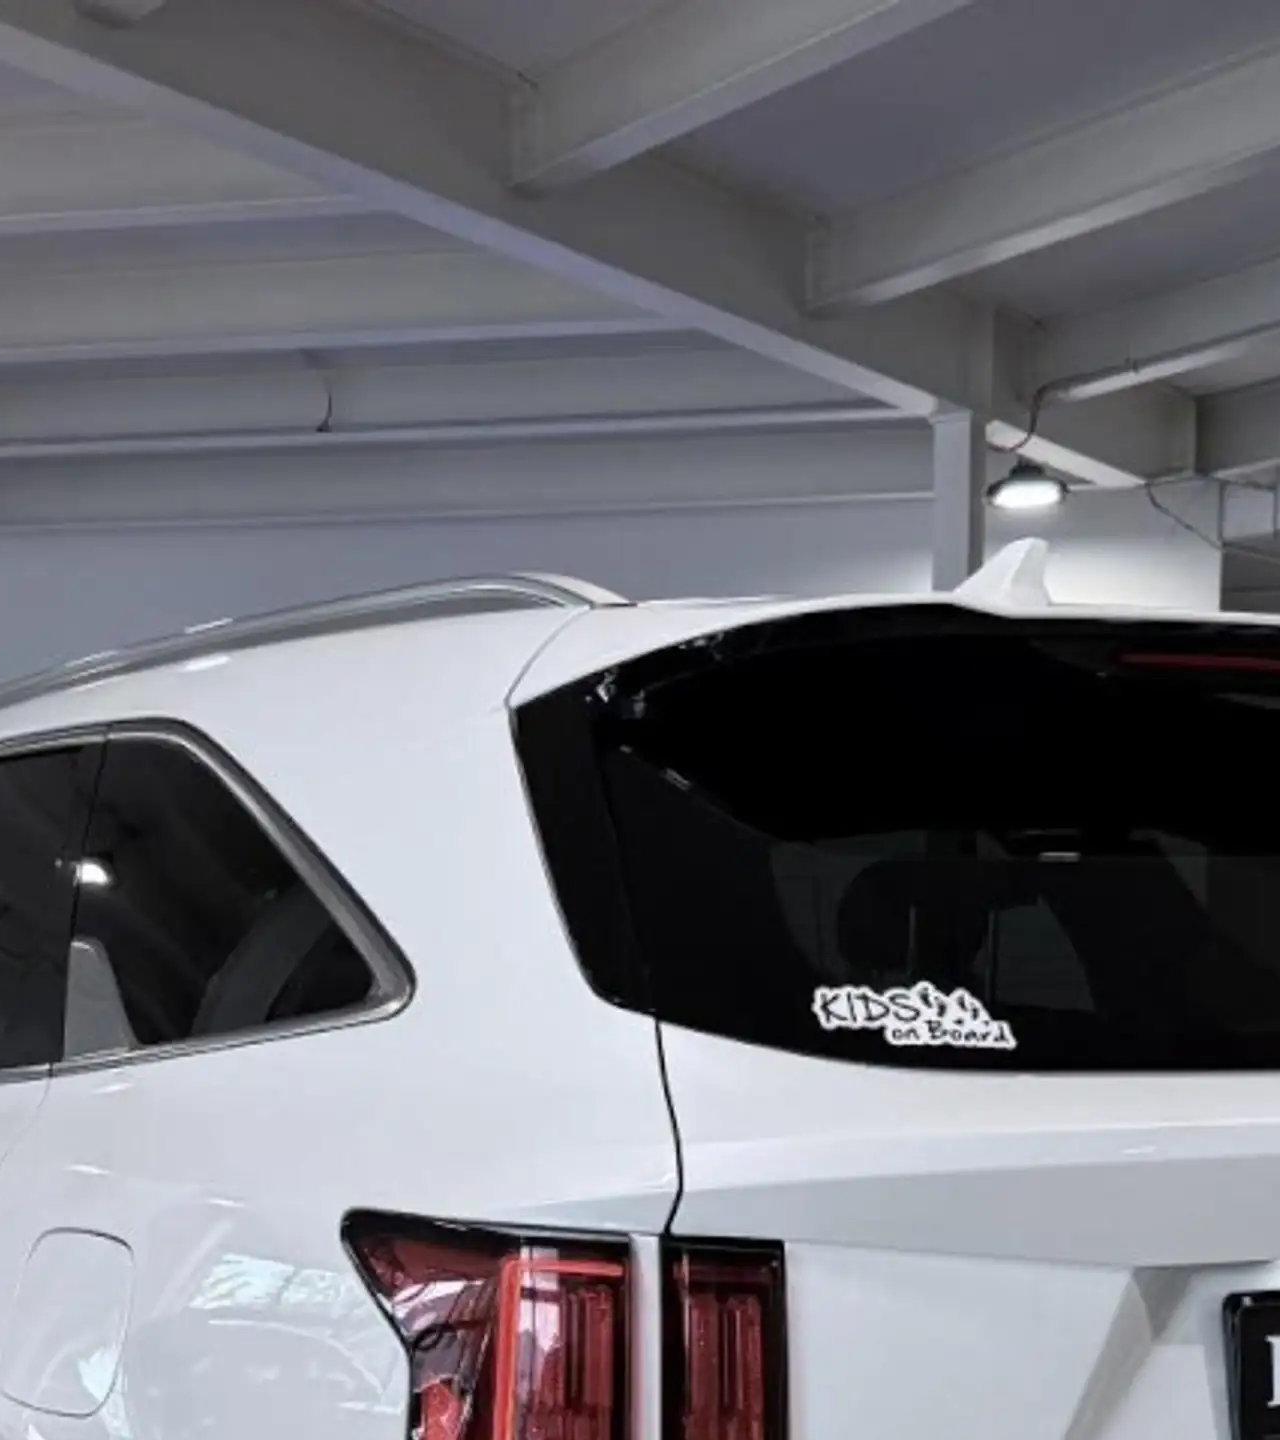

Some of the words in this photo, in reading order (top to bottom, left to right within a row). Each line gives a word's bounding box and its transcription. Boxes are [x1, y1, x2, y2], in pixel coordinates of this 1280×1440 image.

[819, 990, 921, 1024] KIDS
[891, 1027, 920, 1042] on
[924, 1018, 1010, 1043] Board
